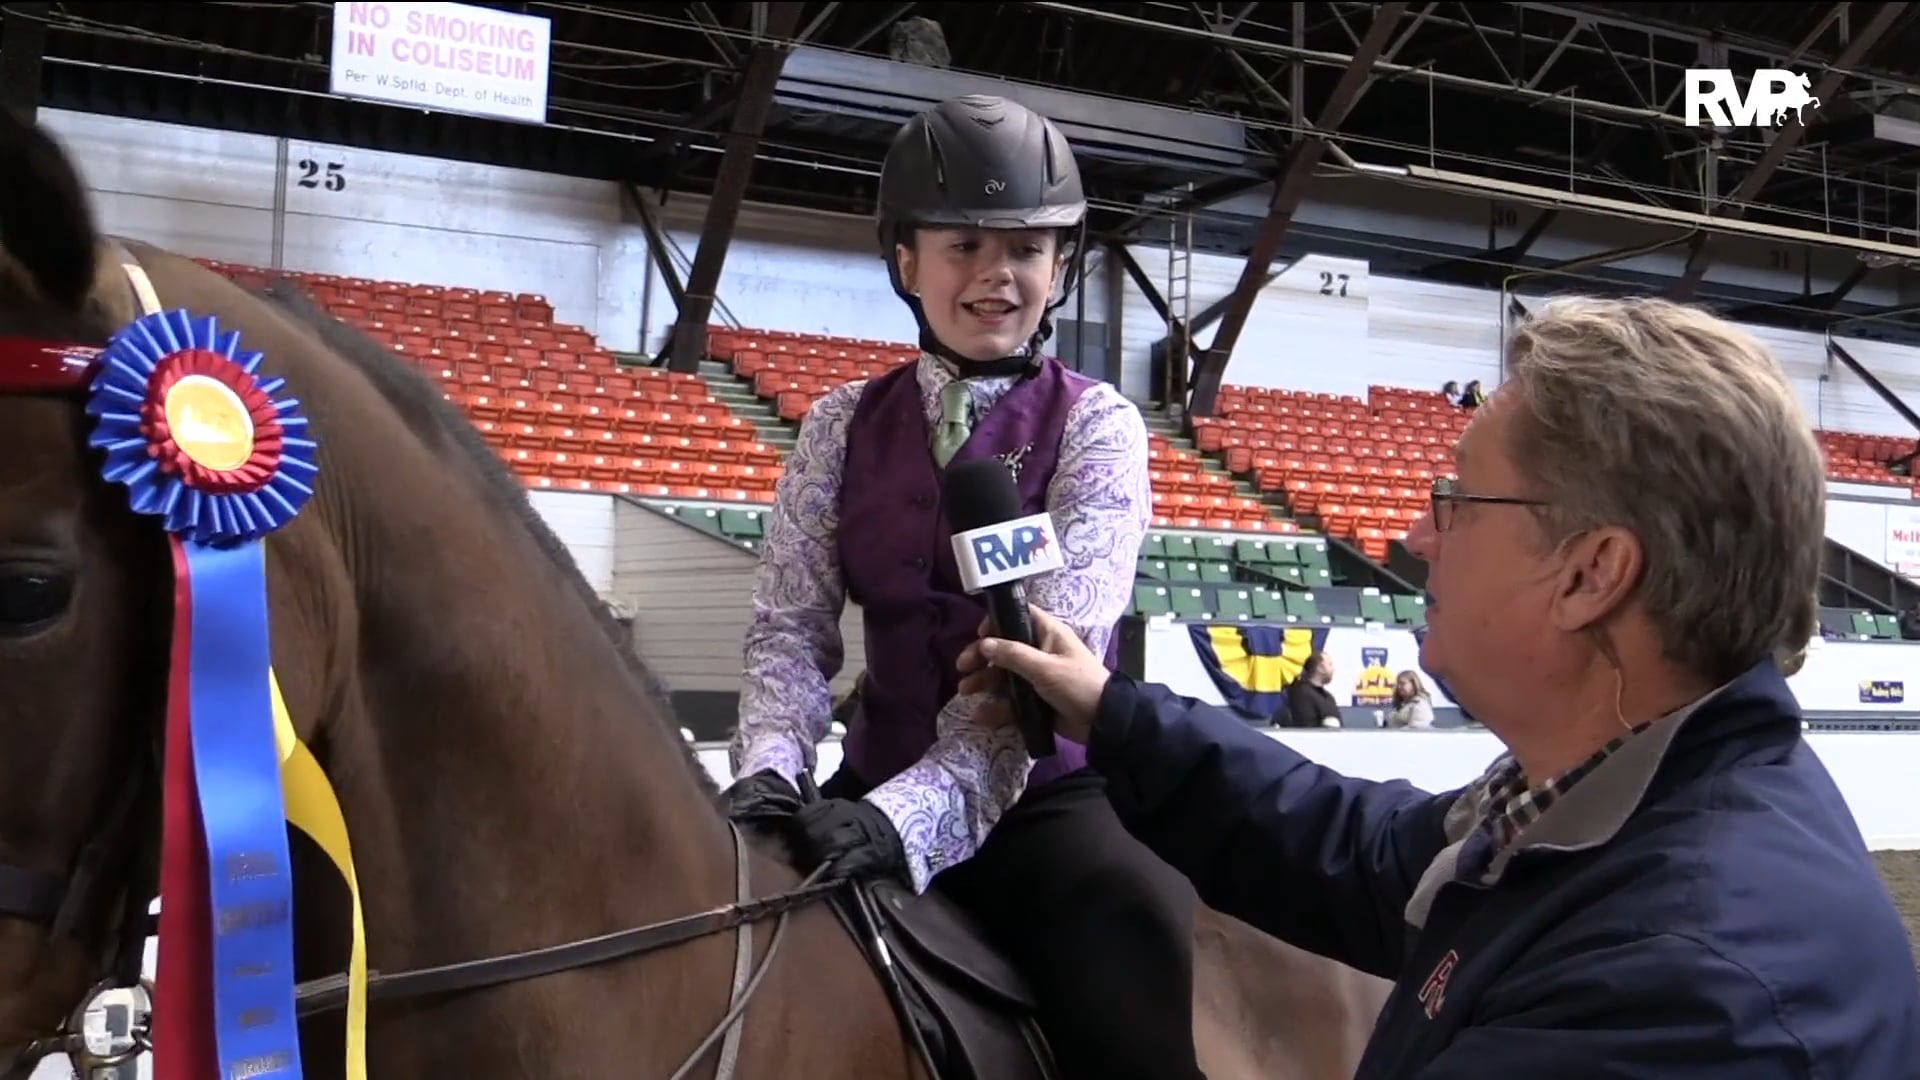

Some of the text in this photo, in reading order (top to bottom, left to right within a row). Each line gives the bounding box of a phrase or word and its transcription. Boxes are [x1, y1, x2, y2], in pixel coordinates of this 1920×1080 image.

[349, 2, 535, 53] NO SMOKING
[347, 30, 535, 81] IN COLISEUM
[345, 69, 368, 83] Per
[474, 89, 488, 101] of
[493, 91, 533, 107] Health
[297, 158, 346, 192] 25
[1319, 271, 1350, 298] 27
[971, 525, 1042, 576] RVP
